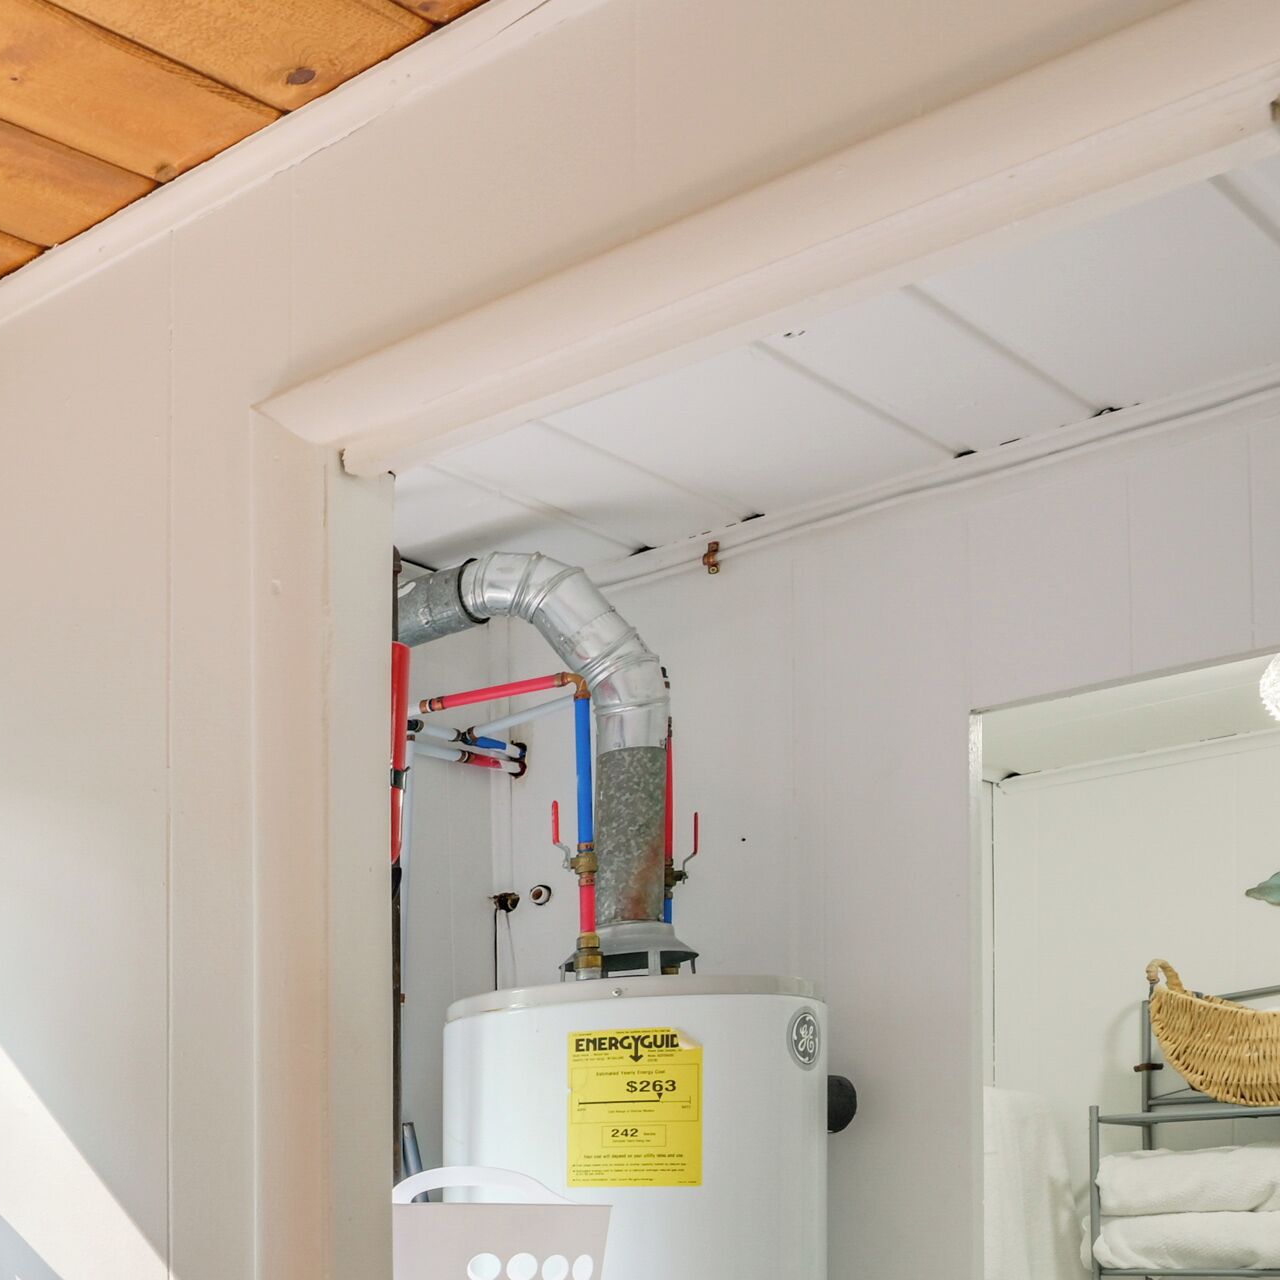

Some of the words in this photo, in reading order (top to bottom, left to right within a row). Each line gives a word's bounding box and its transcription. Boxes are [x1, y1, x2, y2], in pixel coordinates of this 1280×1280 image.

[575, 1033, 680, 1054] ENERGYGUID
[626, 1080, 677, 1094] $263
[611, 1128, 639, 1138] 242
